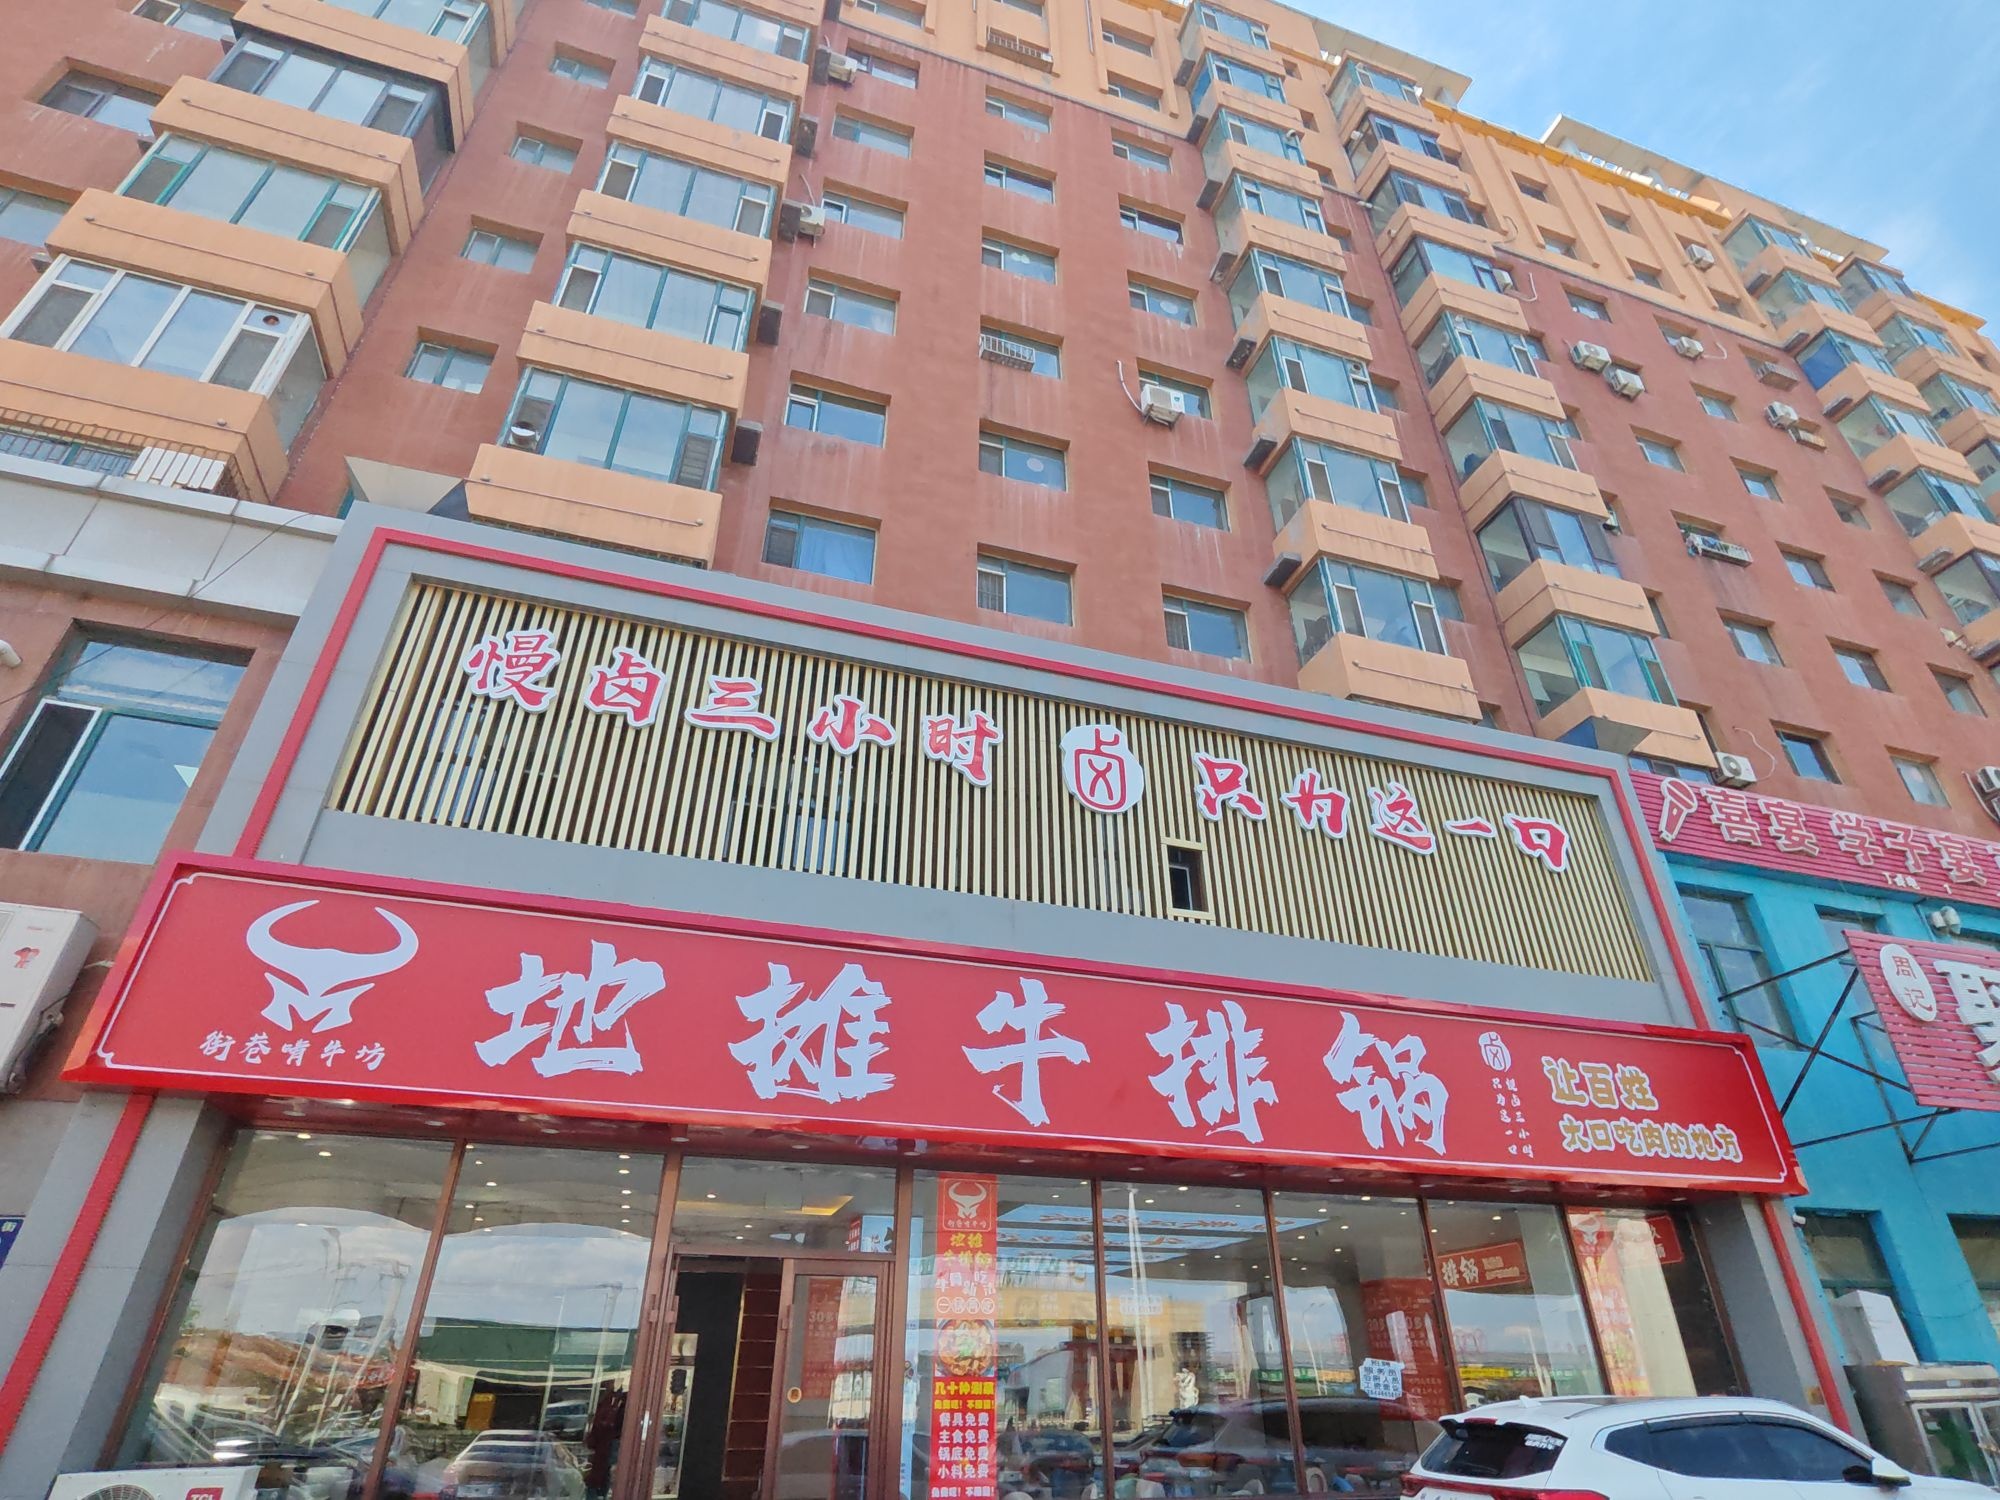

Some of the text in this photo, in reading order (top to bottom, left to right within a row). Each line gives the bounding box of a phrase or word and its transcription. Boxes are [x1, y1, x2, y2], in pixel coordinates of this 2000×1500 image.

[463, 628, 1003, 787] 慢卤三小时
[1194, 752, 1570, 873] 只为这一口
[1701, 787, 2000, 888] 喜宴学子宴
[199, 1030, 386, 1071] 街巷啃牛坊
[474, 939, 1449, 1156] 地摊牛排锅
[1541, 1056, 1659, 1111] 让百姓
[1559, 1113, 1743, 1163] 大口吃肉的地方
[938, 1429, 990, 1444] 主食免费
